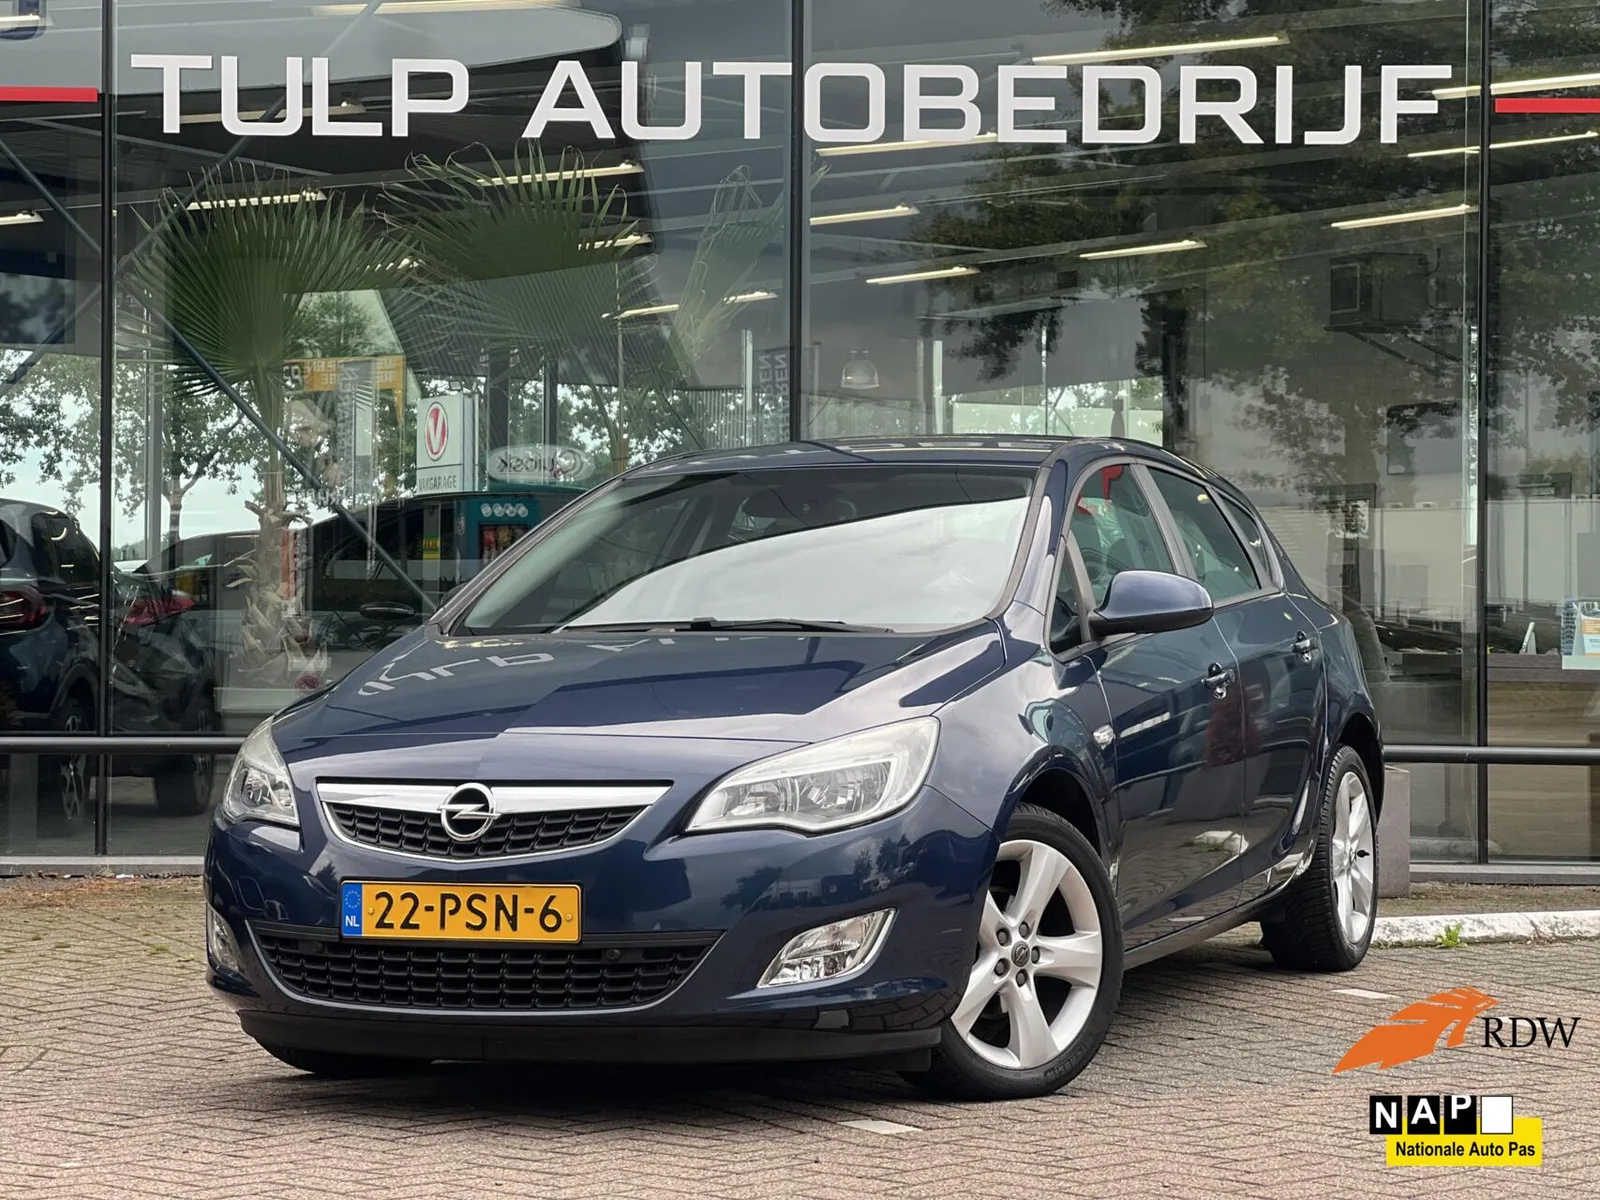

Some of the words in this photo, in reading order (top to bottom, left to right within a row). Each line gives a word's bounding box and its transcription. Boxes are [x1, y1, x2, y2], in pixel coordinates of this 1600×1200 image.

[130, 53, 470, 137] TULP
[521, 59, 1453, 145] AUTOBEDRIJF
[345, 915, 360, 927] NL
[374, 891, 562, 933] 22-PSN-6
